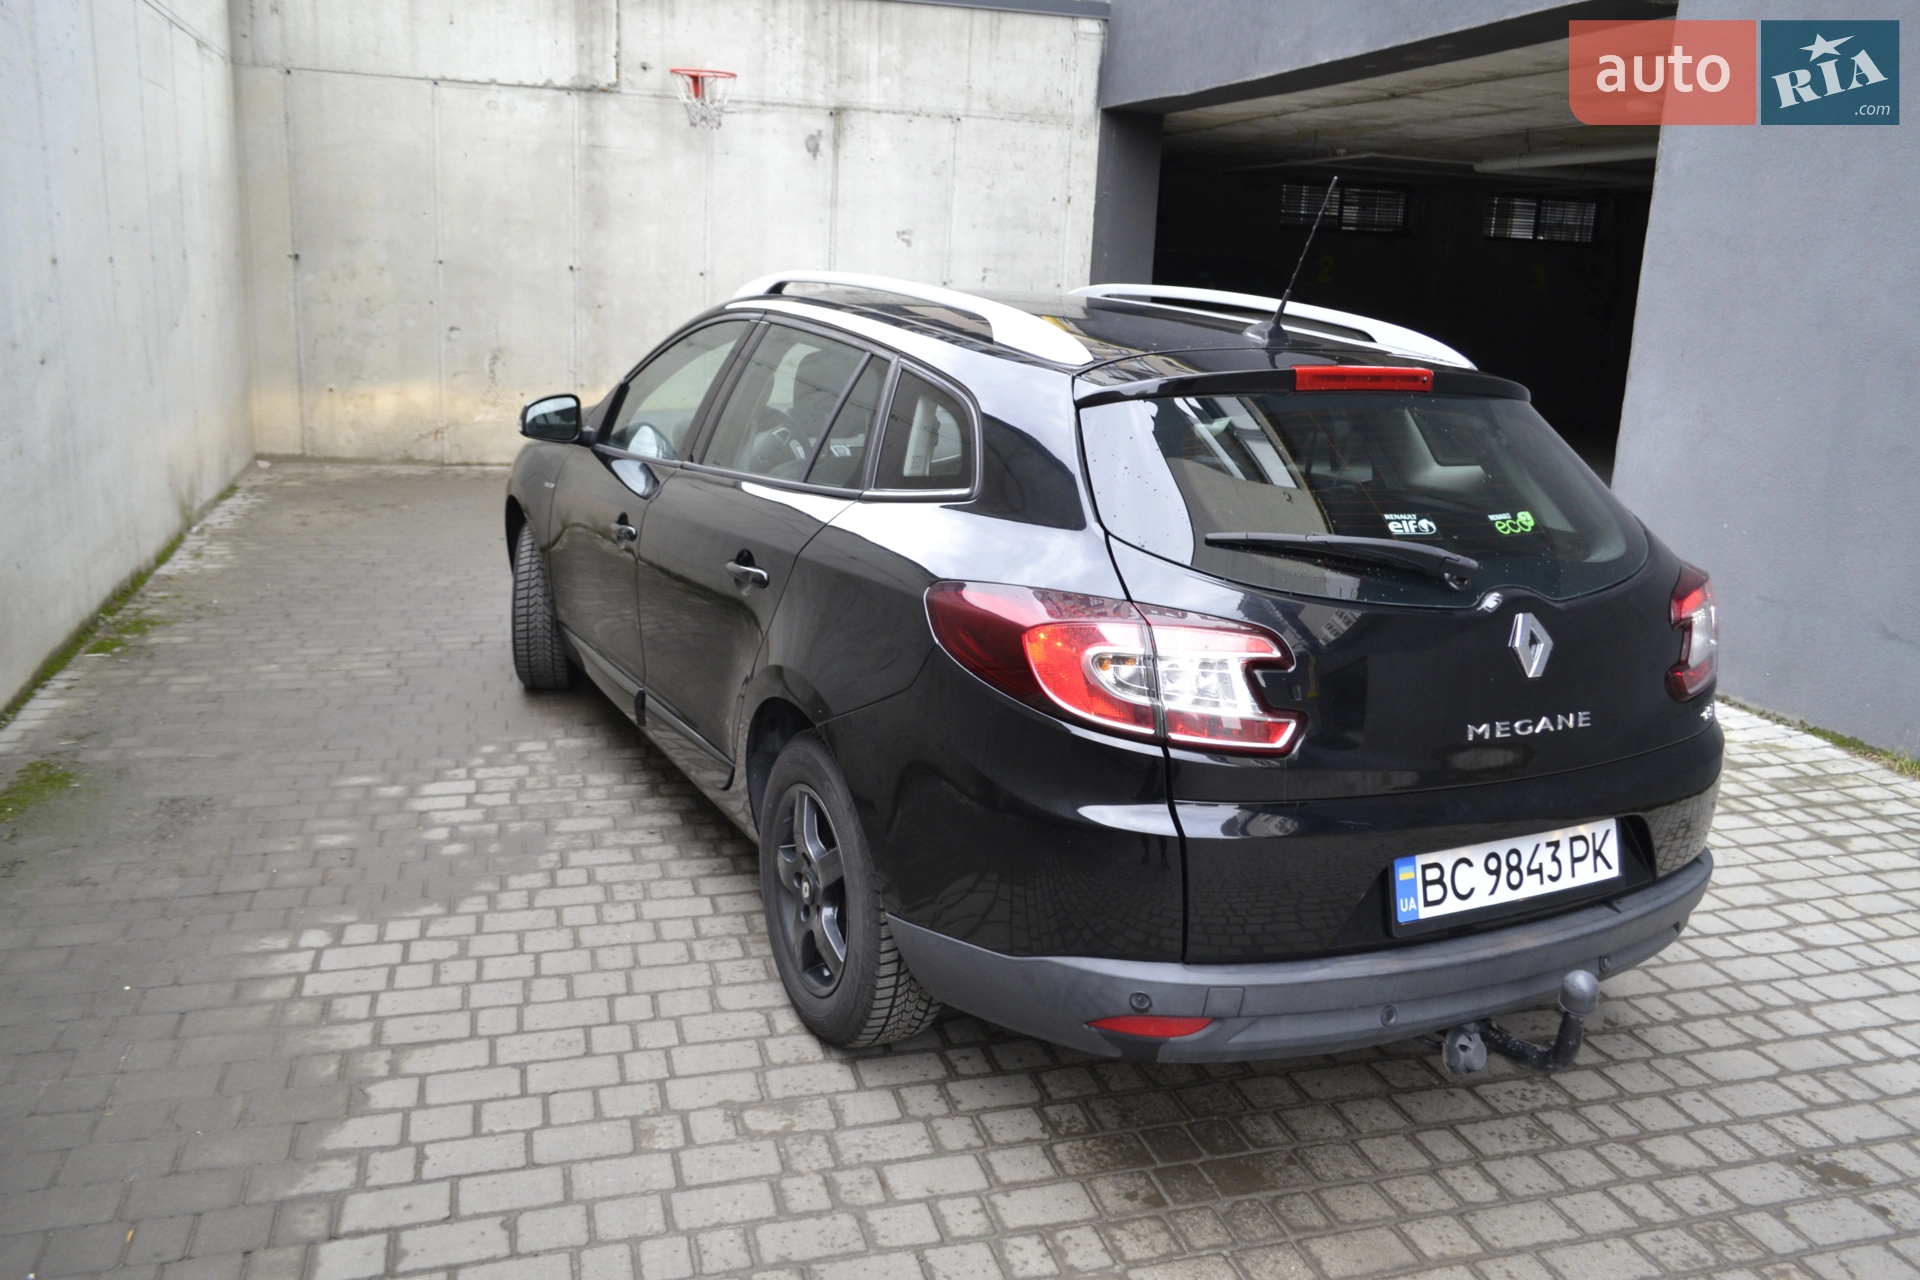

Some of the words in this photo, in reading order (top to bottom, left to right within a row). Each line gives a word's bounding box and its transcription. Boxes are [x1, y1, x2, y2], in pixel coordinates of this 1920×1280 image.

[1315, 255, 1335, 284] 2
[1530, 264, 1548, 293] 3
[1384, 513, 1417, 521] RENAULT
[1387, 519, 1418, 534] elf
[1488, 512, 1512, 521] RENAULT
[1467, 711, 1592, 741] MEGANE
[1420, 857, 1476, 909] BC
[1483, 839, 1563, 897] 9843
[1568, 828, 1614, 879] PK
[1400, 896, 1418, 913] UA
